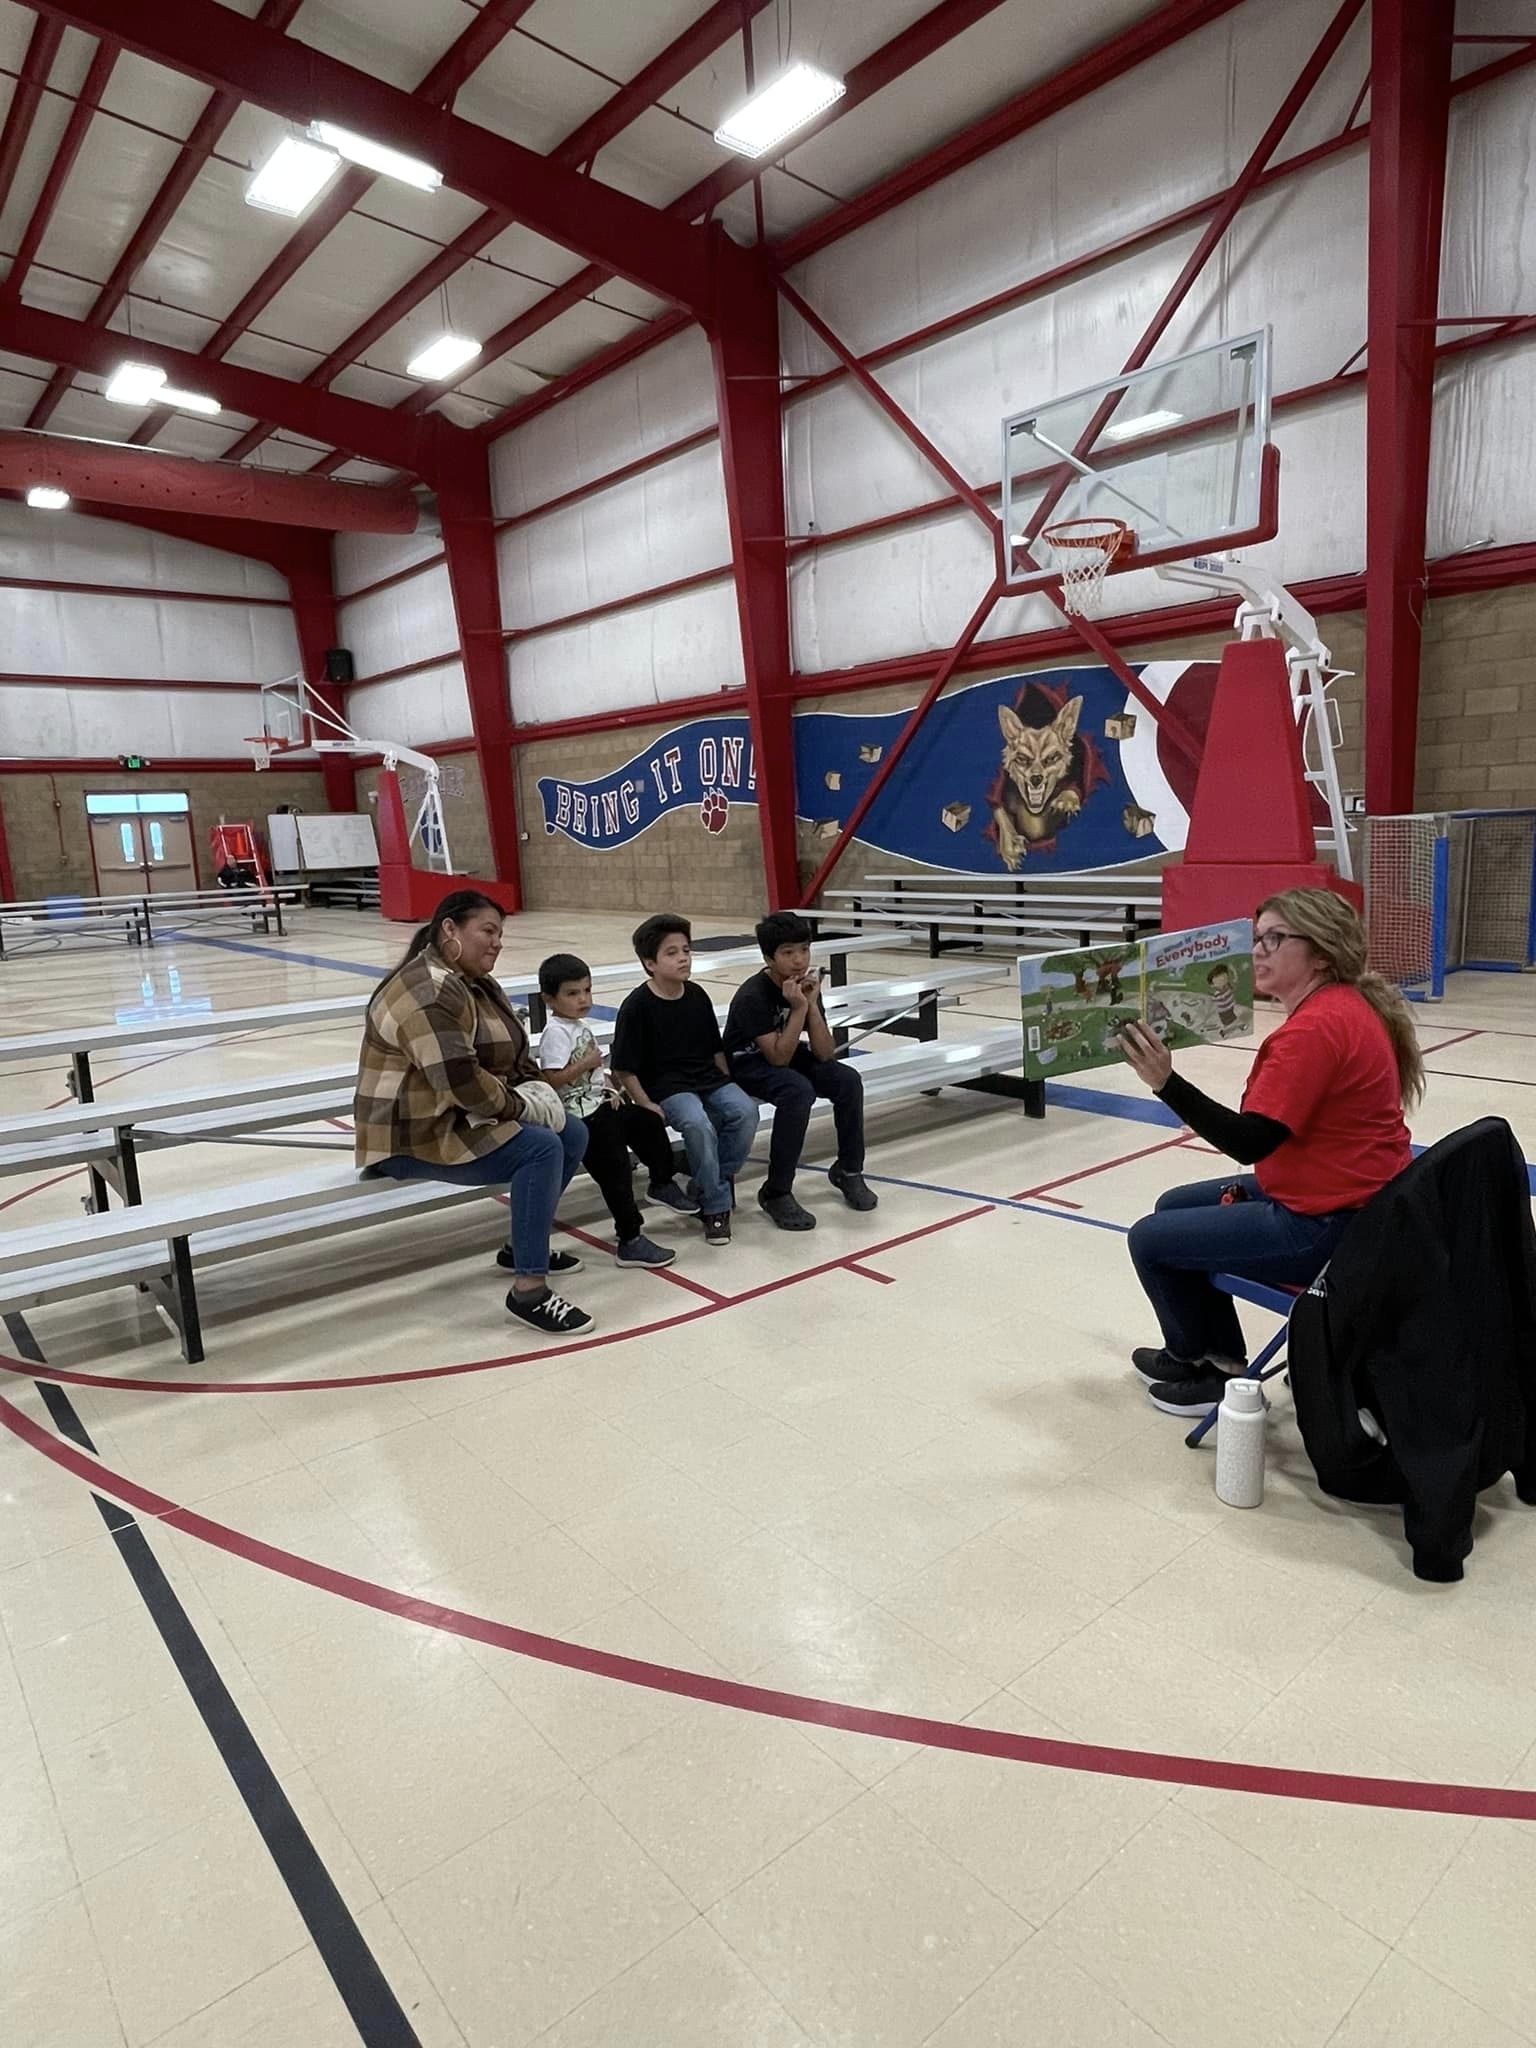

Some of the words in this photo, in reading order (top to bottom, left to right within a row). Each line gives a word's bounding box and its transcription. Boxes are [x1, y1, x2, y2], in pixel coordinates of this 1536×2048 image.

[555, 780, 640, 838] BRING
[650, 746, 682, 804] IT
[1156, 934, 1229, 968] Everybody
